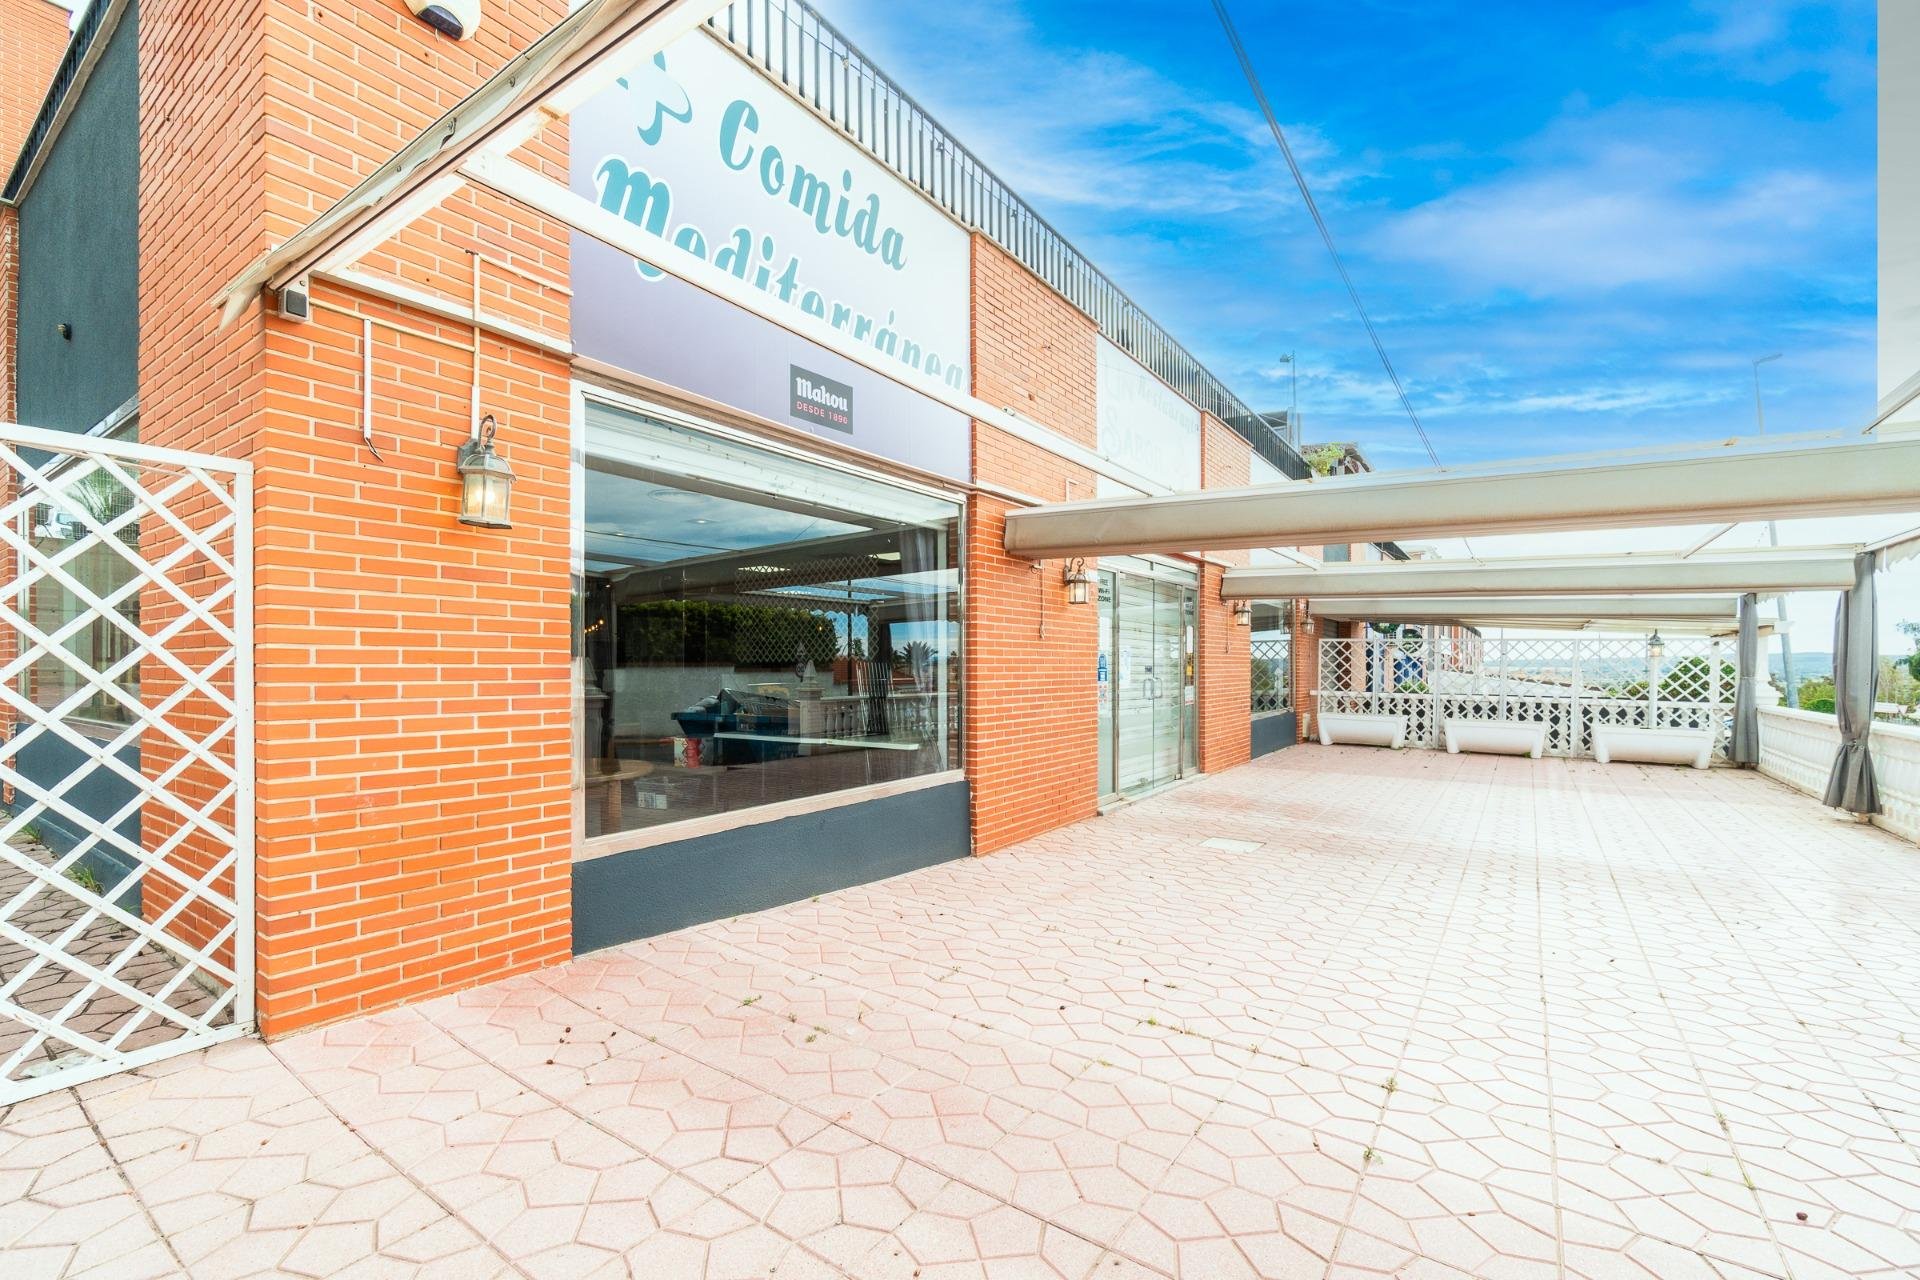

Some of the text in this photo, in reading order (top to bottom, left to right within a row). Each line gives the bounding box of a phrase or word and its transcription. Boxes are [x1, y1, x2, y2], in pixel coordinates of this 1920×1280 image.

[719, 99, 908, 271] Comida
[795, 376, 849, 412] Mahou
[796, 401, 848, 425] DESDE 1890
